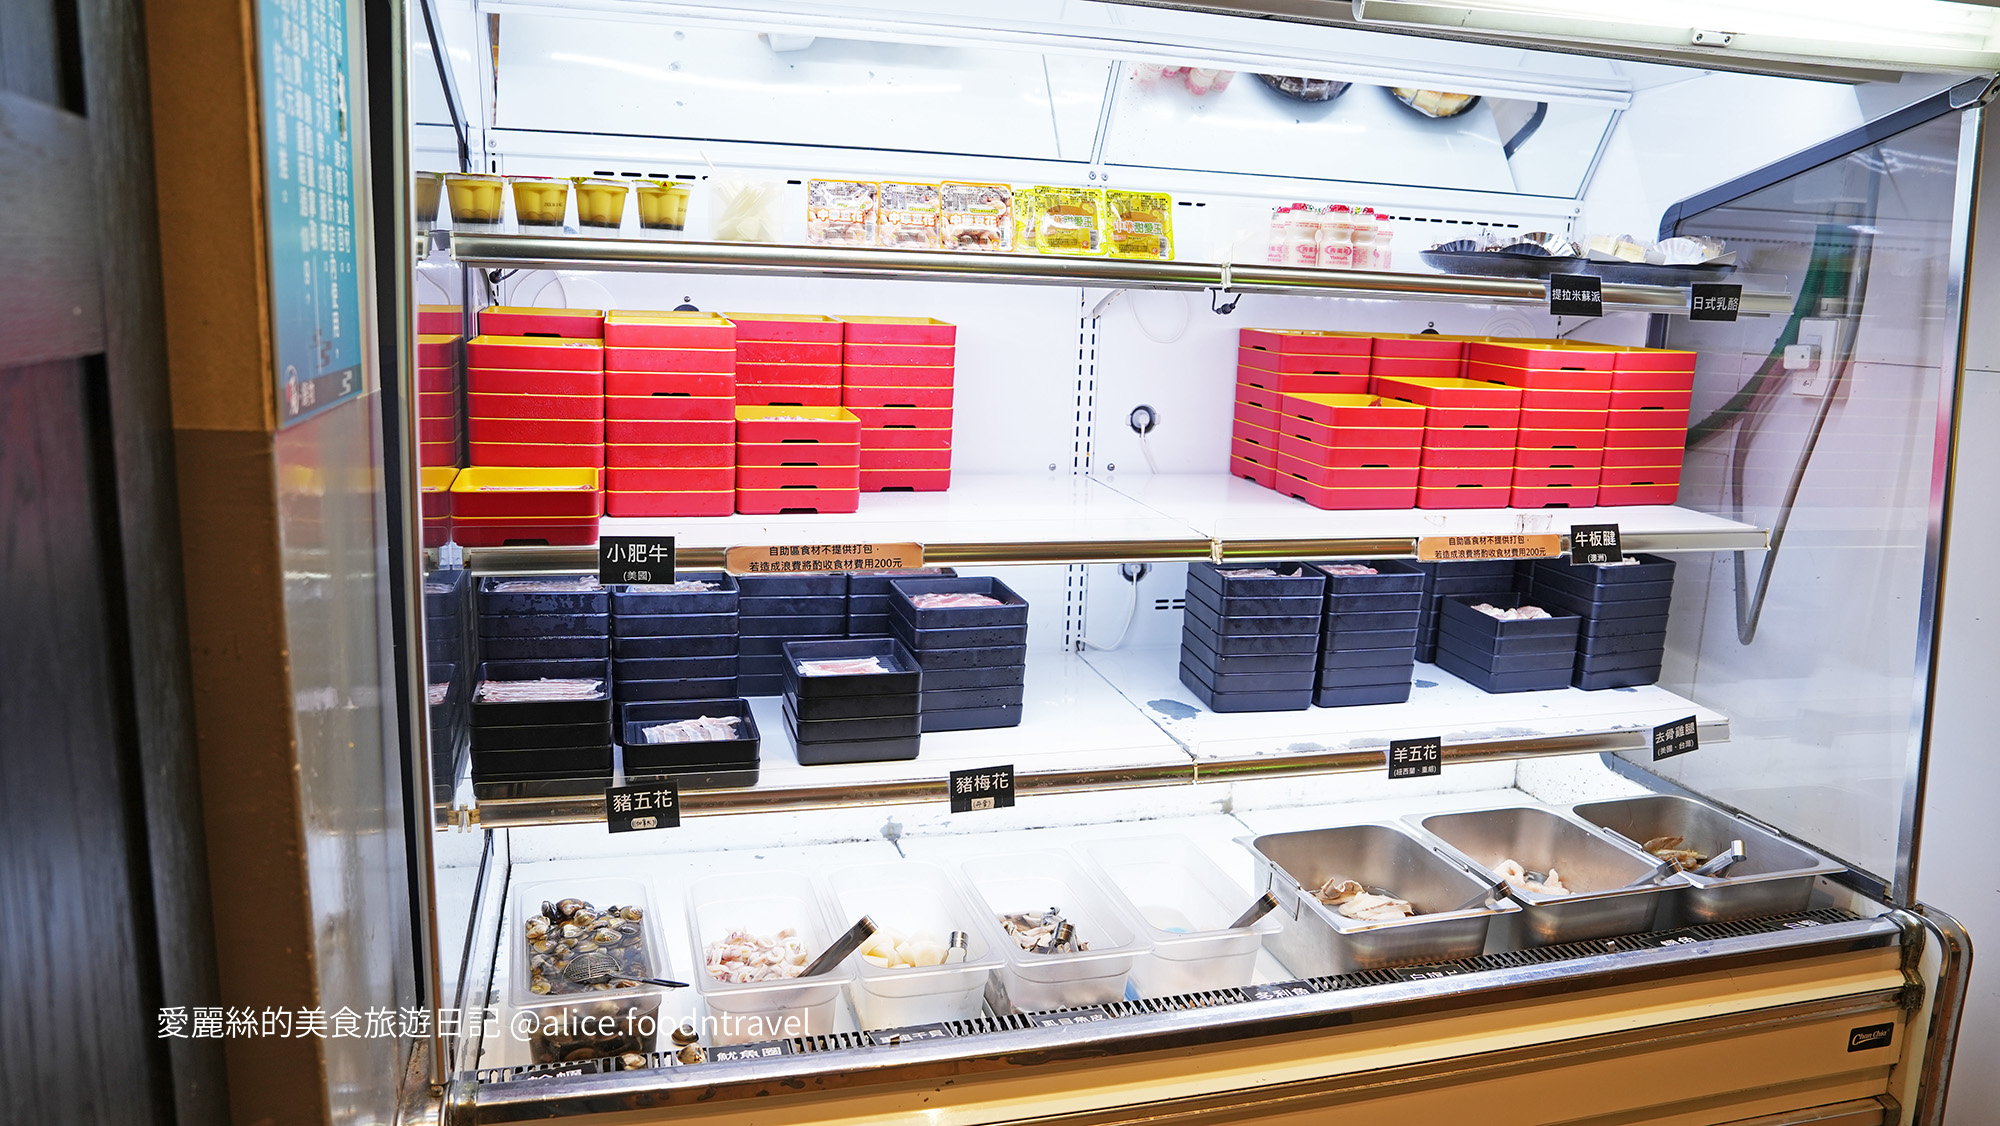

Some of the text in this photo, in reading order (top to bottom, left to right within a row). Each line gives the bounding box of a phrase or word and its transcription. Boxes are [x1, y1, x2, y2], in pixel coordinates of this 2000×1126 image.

[1552, 289, 1601, 303] 提拉米蘇派
[1693, 296, 1739, 311] 日式乳酪
[1575, 530, 1617, 547] 牛板腱
[606, 543, 669, 563] 小肥牛
[1434, 547, 1546, 559] 若造成浪費將酌收食材費用200元
[1587, 553, 1607, 564] (澳洲)
[749, 557, 903, 572] 若造成浪費將酌收食材費用200元
[623, 570, 652, 582] (美國)
[1655, 721, 1695, 744] 去骨雞腿
[1394, 744, 1437, 763] 羊五花
[956, 771, 1009, 794] 豬梅花
[613, 789, 673, 813] 豬五花
[716, 1046, 782, 1062] 魷魚圈
